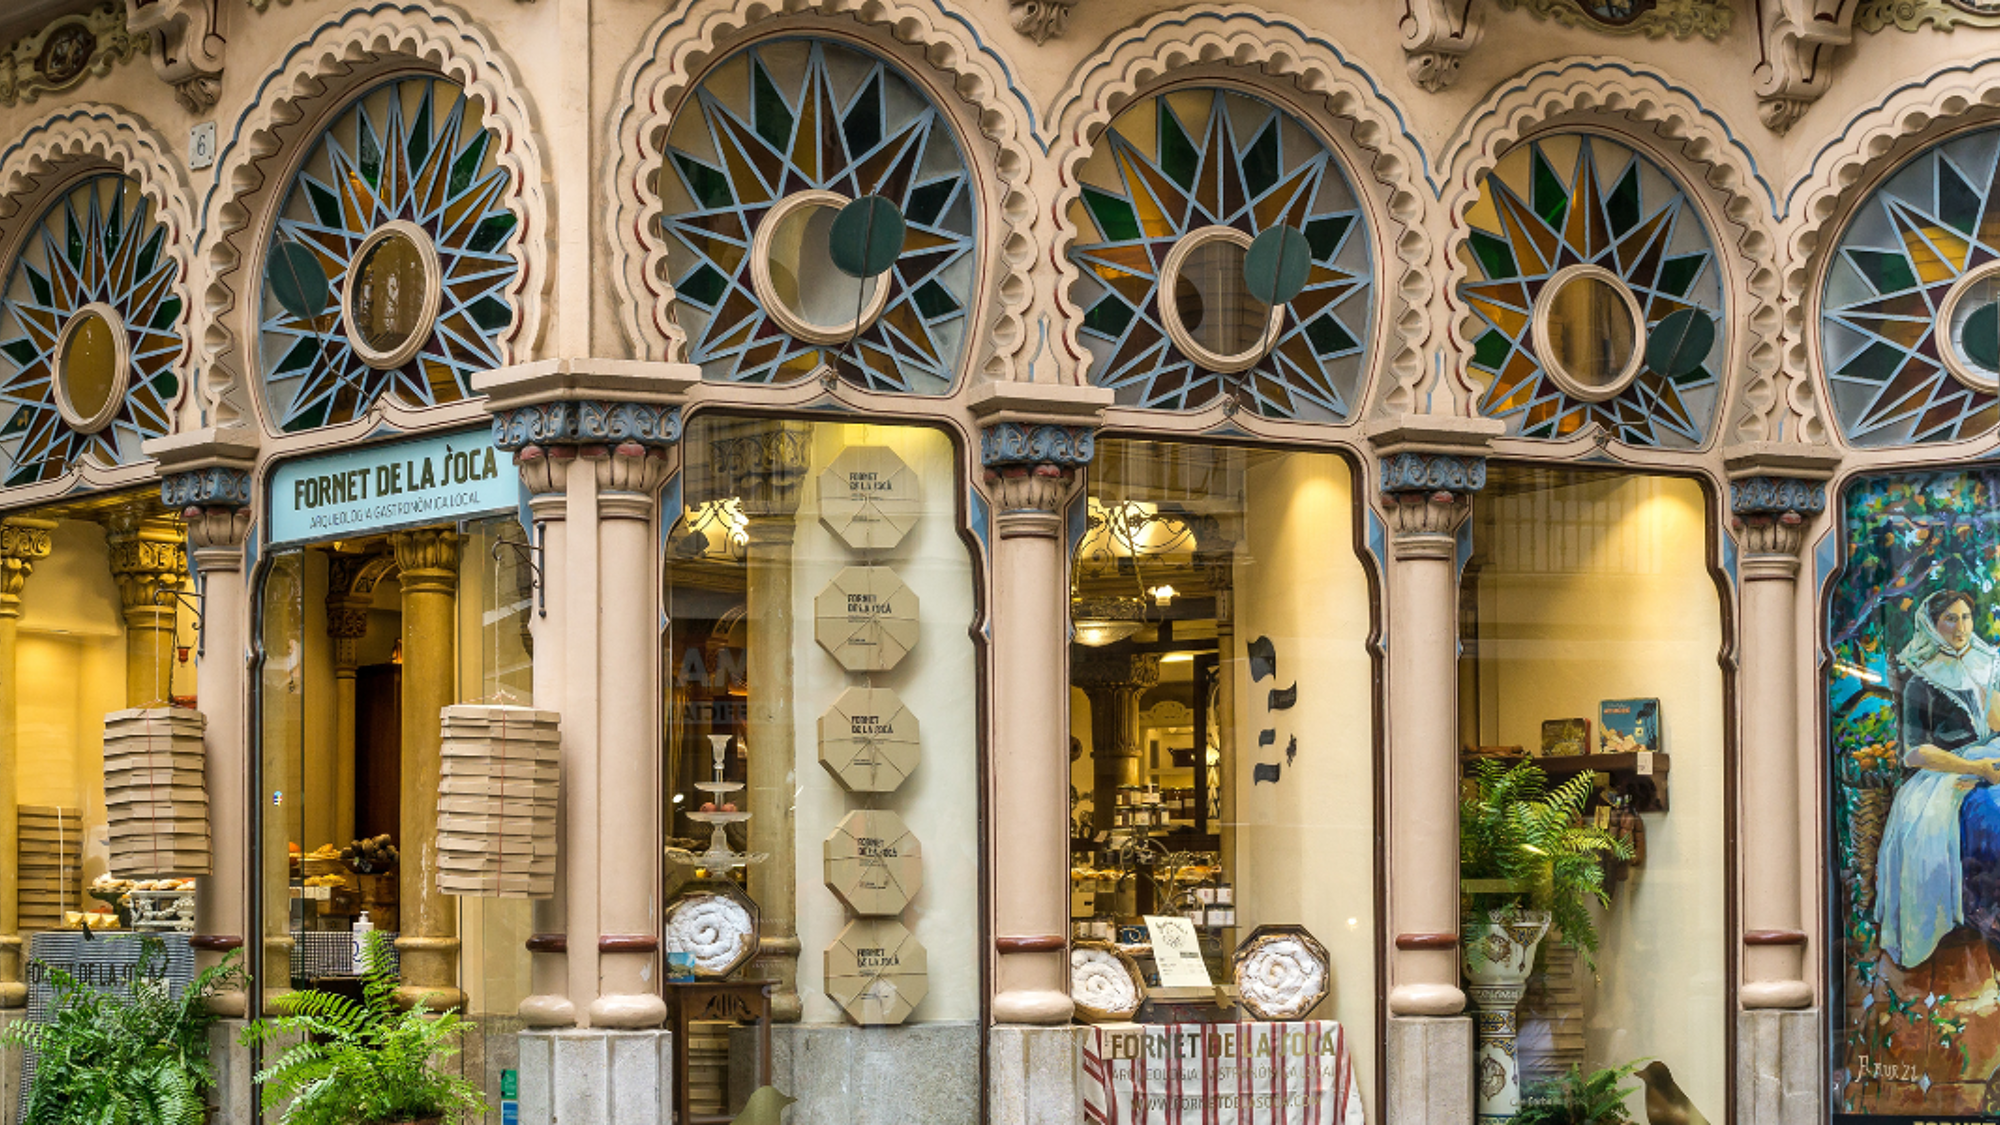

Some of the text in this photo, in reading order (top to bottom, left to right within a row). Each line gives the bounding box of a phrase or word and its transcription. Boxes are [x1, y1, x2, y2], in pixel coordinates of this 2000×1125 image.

[197, 134, 206, 156] 6
[294, 468, 370, 510] FORNET
[376, 463, 403, 497] DE
[406, 456, 436, 492] LA
[309, 508, 372, 530] ARQUEOLOGA
[450, 491, 480, 509] LOCAL
[1112, 1034, 1201, 1059] FORNET
[1208, 1033, 1236, 1058] DE
[1243, 1032, 1271, 1058] LA
